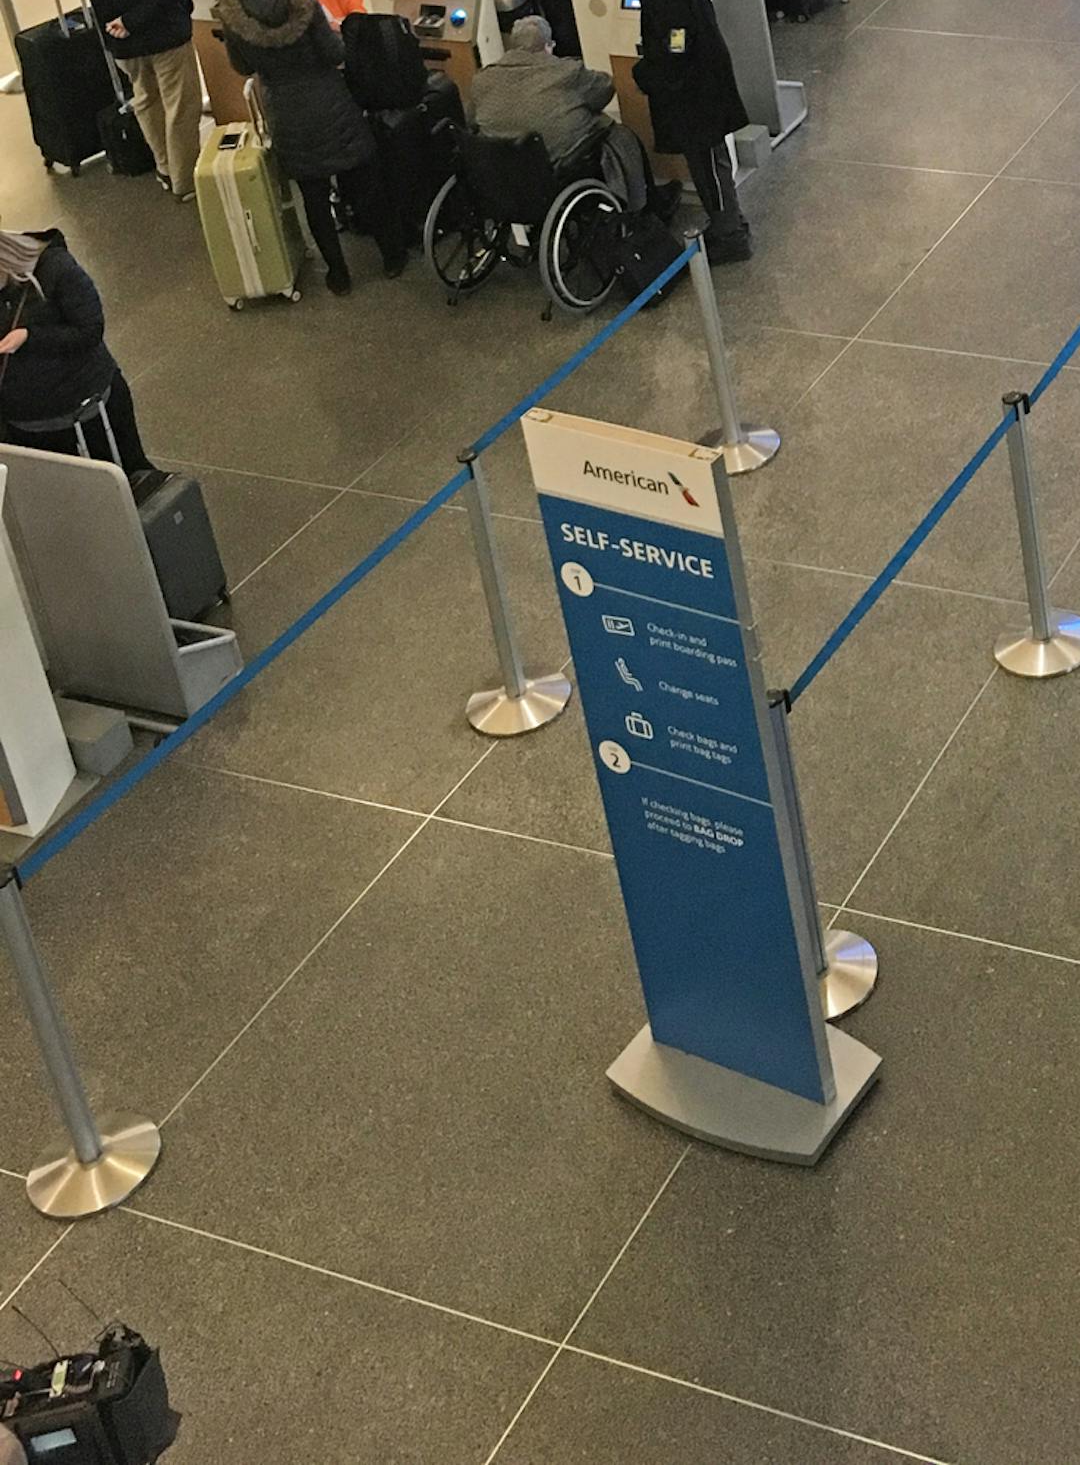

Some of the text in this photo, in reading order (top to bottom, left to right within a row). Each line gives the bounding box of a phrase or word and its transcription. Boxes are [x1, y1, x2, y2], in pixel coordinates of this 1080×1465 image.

[583, 460, 669, 495] American
[560, 522, 714, 579] SELF-SERVICE
[573, 575, 582, 591] 1
[647, 622, 708, 647] Check-in and
[650, 636, 738, 668] print boarding pass
[658, 681, 720, 706] Change seats
[667, 725, 738, 754] Check bags and
[670, 739, 733, 765] print bag tags
[610, 753, 621, 768] 2
[693, 823, 715, 839] BAG
[715, 833, 744, 848] DROP
